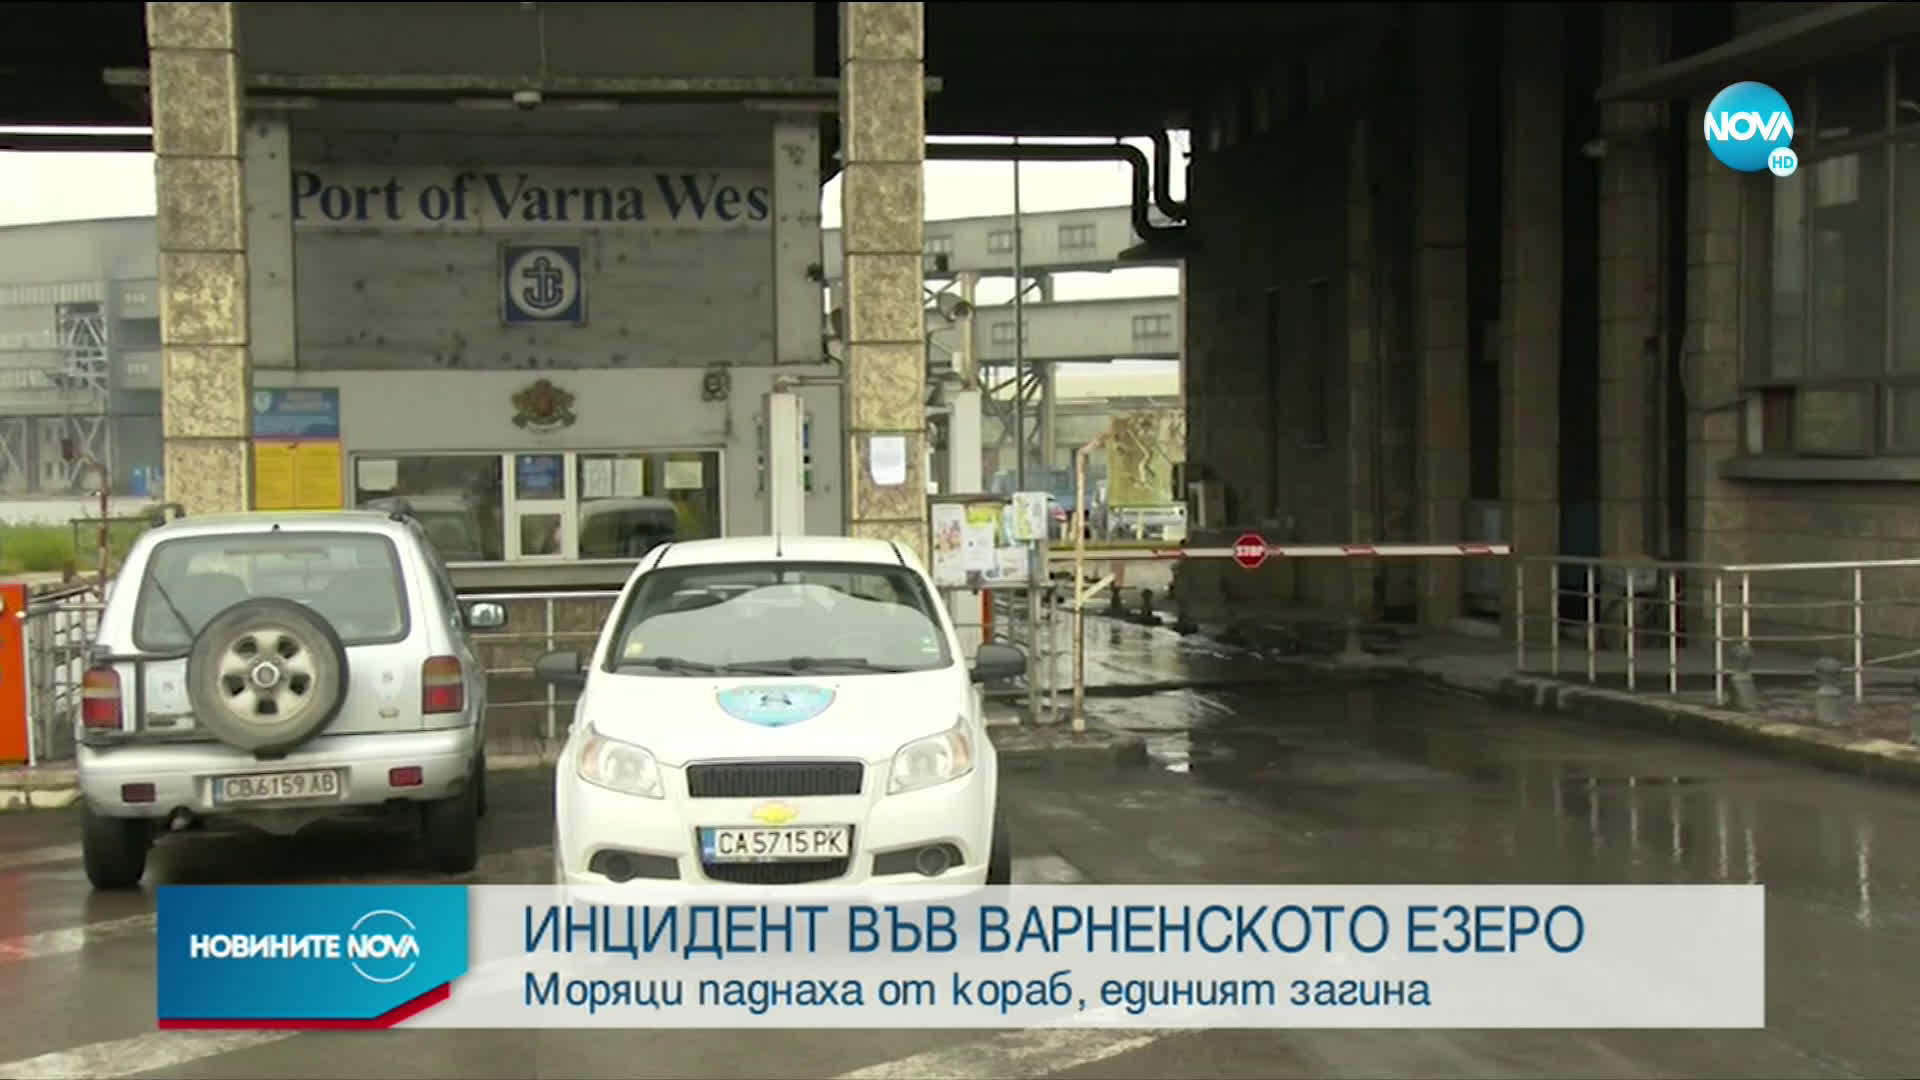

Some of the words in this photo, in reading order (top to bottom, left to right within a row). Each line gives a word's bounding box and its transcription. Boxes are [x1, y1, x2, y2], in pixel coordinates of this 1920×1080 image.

[293, 172, 403, 222] Port
[419, 171, 477, 222] of
[482, 174, 646, 222] Varna
